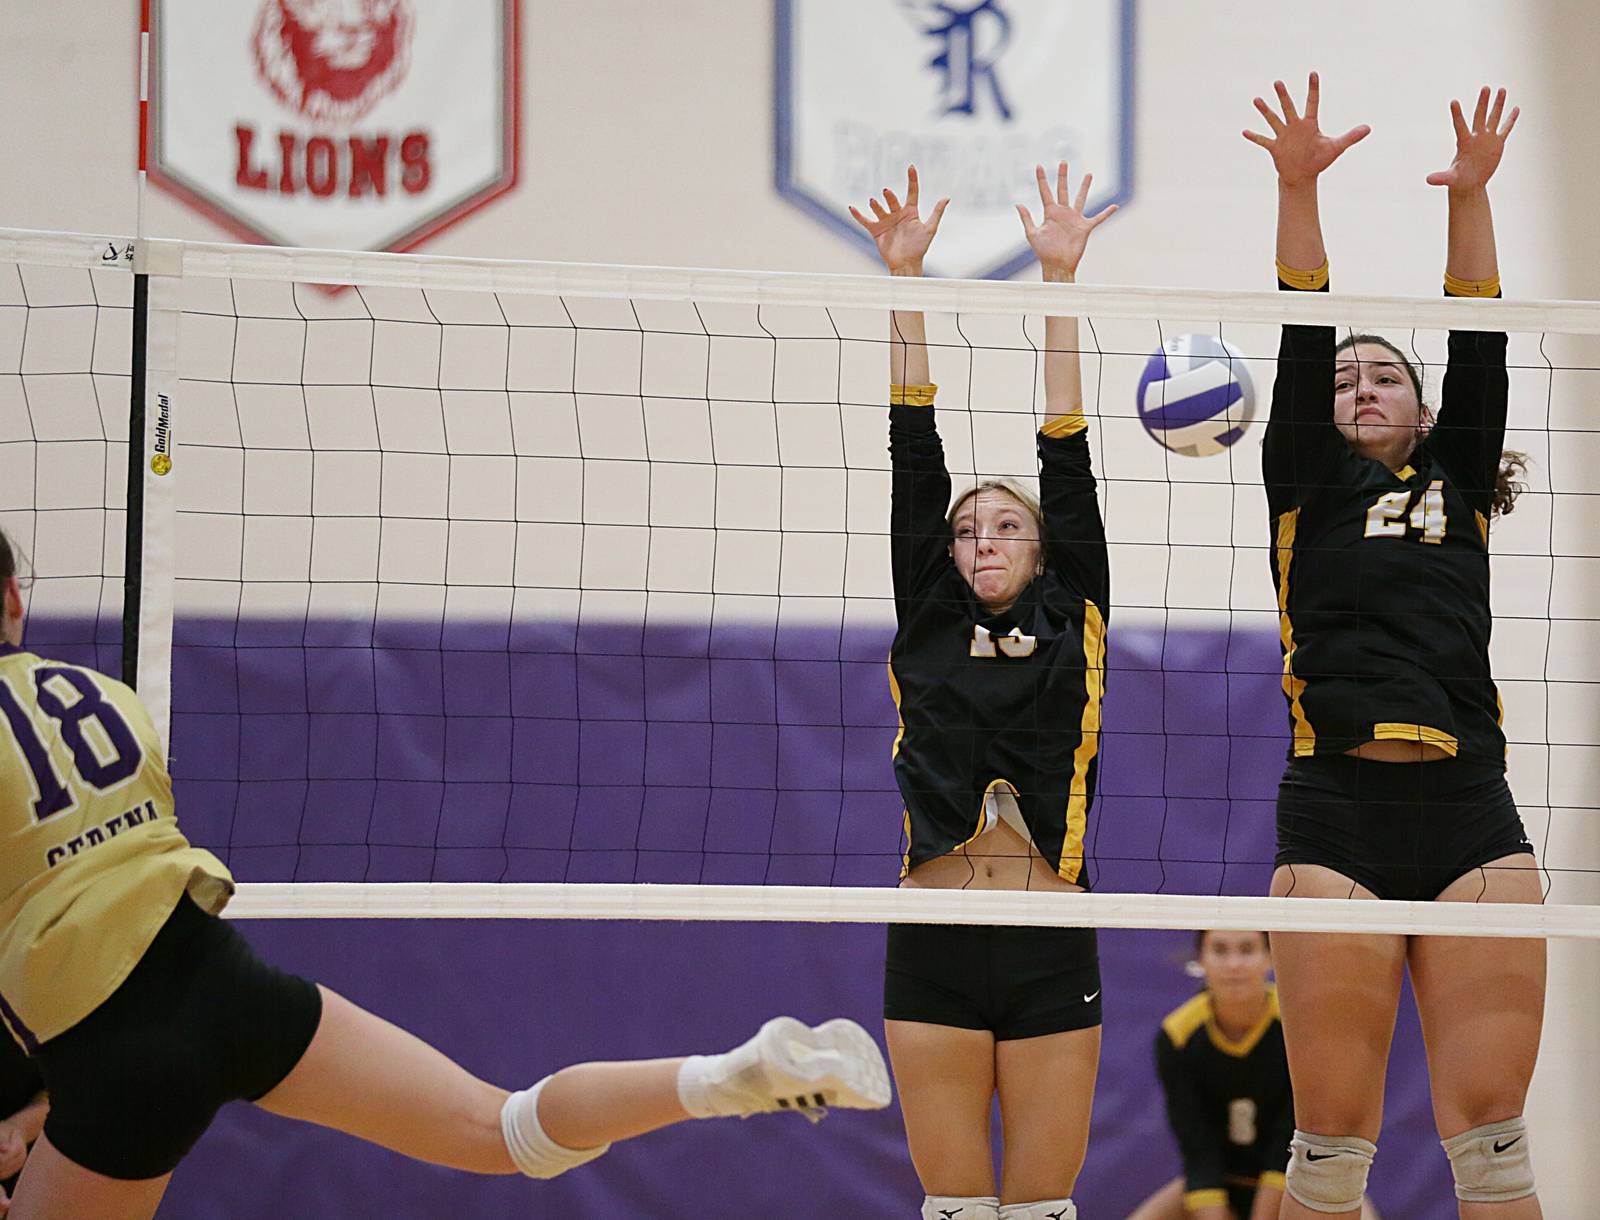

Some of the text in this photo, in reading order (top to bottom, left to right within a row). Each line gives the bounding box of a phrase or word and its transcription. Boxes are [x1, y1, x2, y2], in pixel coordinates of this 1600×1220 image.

[234, 124, 432, 198] LIONS
[1363, 480, 1447, 545] 24
[0, 662, 146, 825] 18
